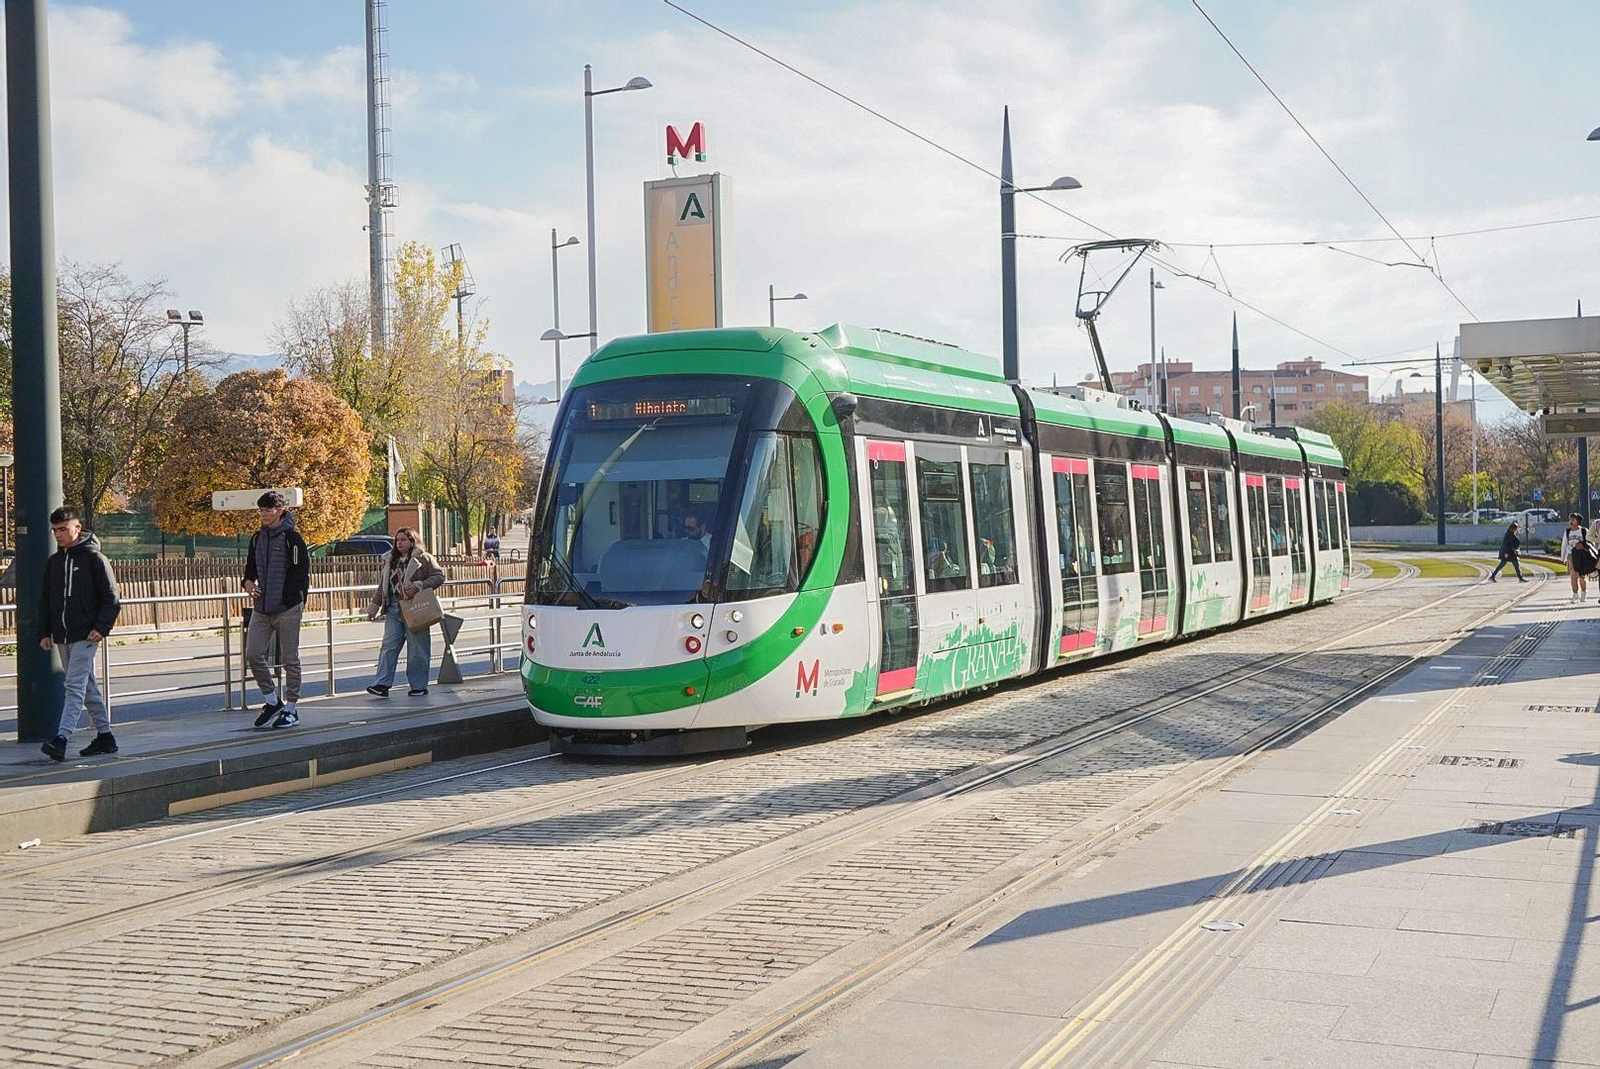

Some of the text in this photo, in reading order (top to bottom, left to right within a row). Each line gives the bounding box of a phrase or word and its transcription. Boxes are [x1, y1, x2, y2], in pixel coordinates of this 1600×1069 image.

[666, 122, 705, 165] M
[795, 658, 819, 699] M
[573, 695, 604, 708] CAF
